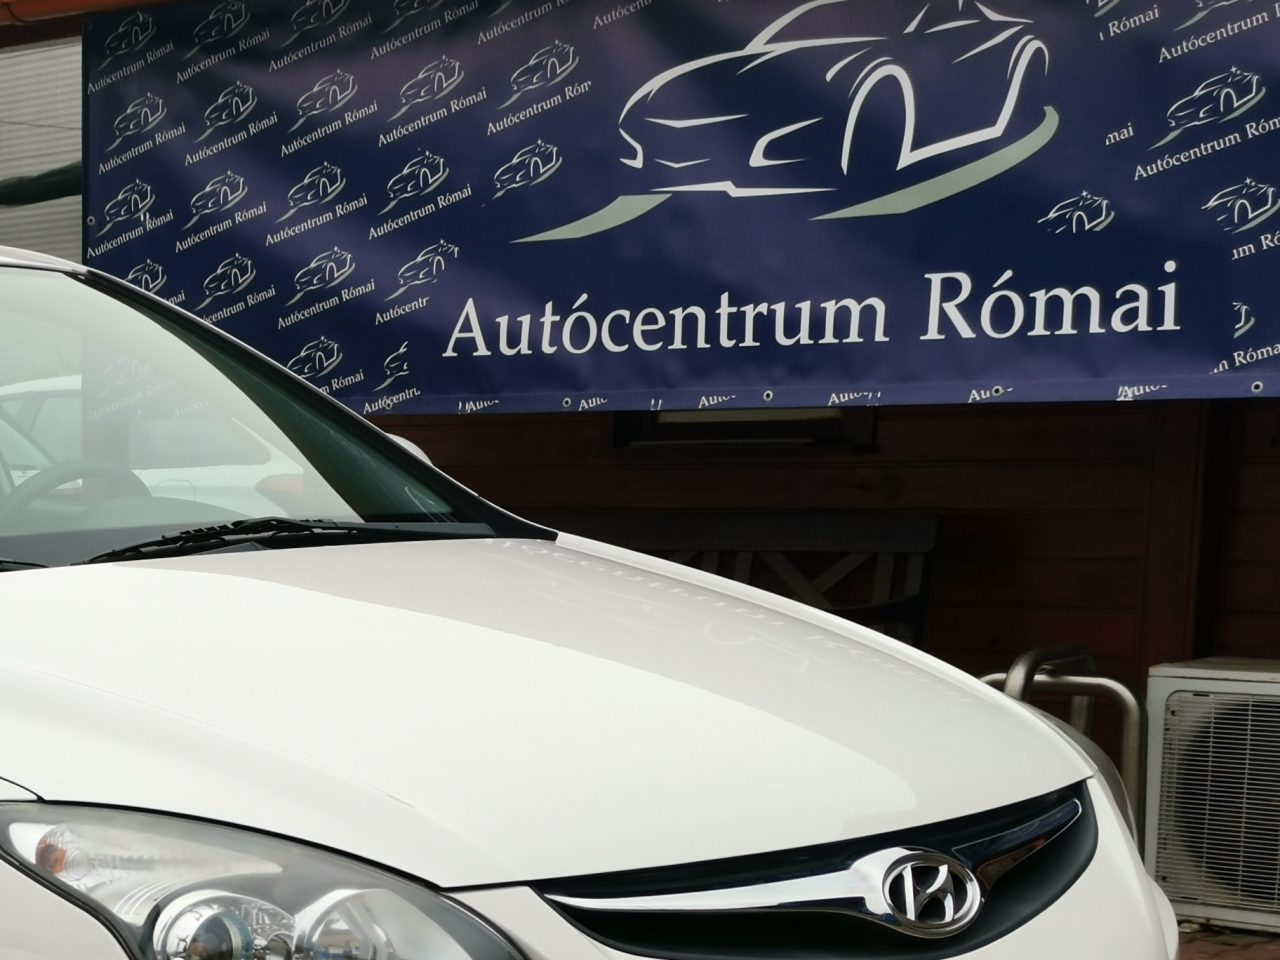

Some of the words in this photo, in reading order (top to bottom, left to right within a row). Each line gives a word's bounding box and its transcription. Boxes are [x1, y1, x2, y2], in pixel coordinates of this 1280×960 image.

[1109, 5, 1159, 37] Római
[1159, 11, 1269, 63] Autócentrum
[185, 133, 246, 166] Autócentrum
[248, 112, 278, 136] Római
[280, 121, 343, 157] Autócentrum
[345, 100, 378, 125] Római
[378, 107, 448, 147] Autócentrum
[450, 87, 487, 113] Római
[487, 95, 562, 136] Autócentrum
[98, 142, 154, 175] Autócentrum
[155, 121, 186, 147] Római
[1134, 134, 1241, 181] Autócentrum
[146, 210, 174, 232] Római
[175, 219, 234, 253] Autócentrum
[235, 201, 267, 226] Római
[266, 212, 331, 246] Autócentrum
[332, 194, 368, 219] Római
[369, 203, 437, 240] Autócentrum
[437, 184, 472, 209] Római
[246, 285, 276, 307] Római
[278, 296, 339, 330] Autócentrum
[341, 279, 375, 300] Római
[442, 291, 889, 356] Autócentrum
[920, 260, 1181, 340] Római
[332, 369, 364, 391] Római
